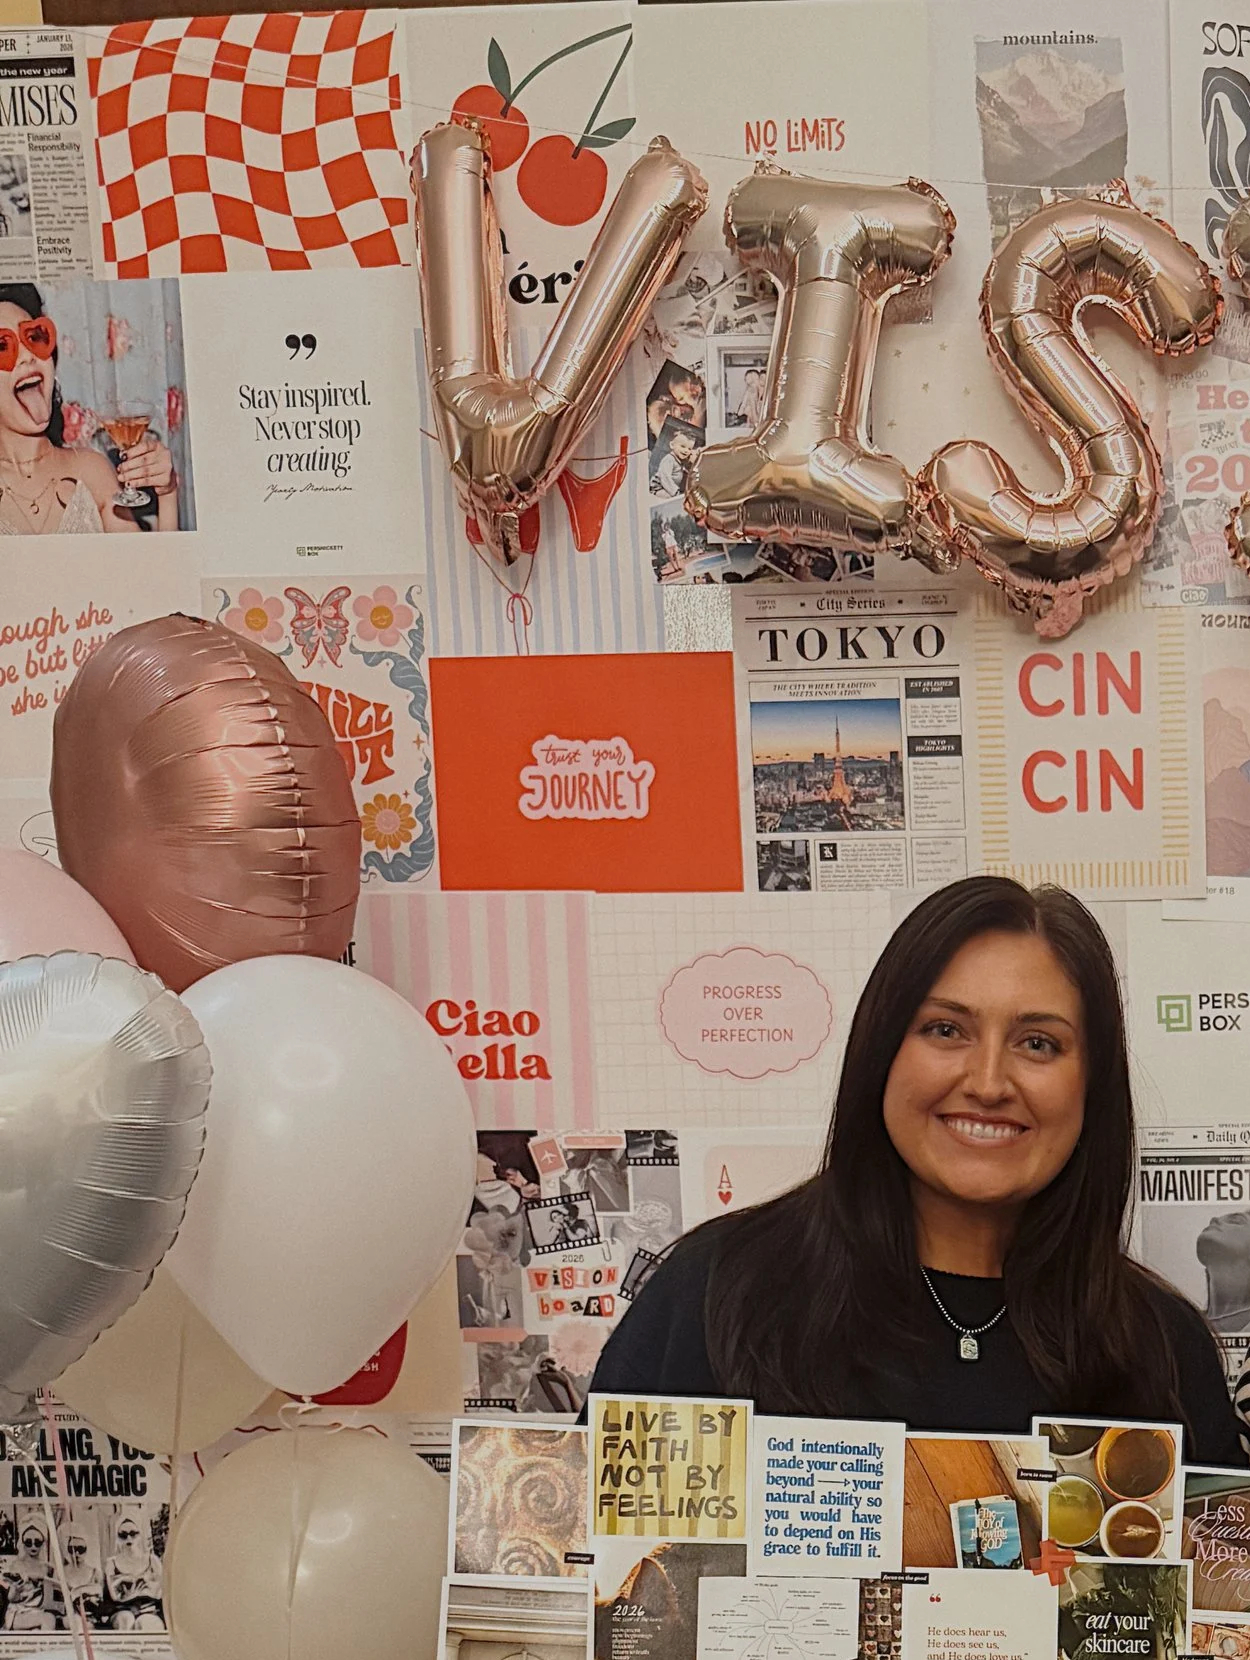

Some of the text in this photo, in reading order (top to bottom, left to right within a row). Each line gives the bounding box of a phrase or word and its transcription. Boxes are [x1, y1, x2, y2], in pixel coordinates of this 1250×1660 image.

[1003, 31, 1099, 45] mountains.
[745, 120, 778, 154] NO
[239, 380, 371, 417] Stay inspired.
[255, 418, 361, 446] Never stop
[267, 446, 352, 477] creating.
[817, 596, 885, 611] City Series
[759, 623, 947, 663] TOKYO
[1018, 651, 1141, 717] CIN
[540, 742, 626, 768] trust your
[528, 769, 649, 810] JOURNEY
[1022, 747, 1144, 814] CIN
[703, 985, 782, 1000] PROGRESS
[426, 1000, 540, 1037] Ciao
[724, 1007, 763, 1021] OVER
[1200, 1014, 1241, 1031] BOX
[701, 1028, 794, 1043] PERFECTION
[1207, 1130, 1236, 1144] Daily
[562, 1254, 584, 1263] 2026
[602, 1409, 736, 1436] LIVE BY
[603, 1436, 688, 1461] FAITH
[67, 1465, 147, 1496] MAGIC
[601, 1464, 724, 1490] NOT BY
[599, 1494, 738, 1520] FEELINGS
[1085, 1613, 1149, 1634] eat your
[1085, 1634, 1149, 1654] skincare
